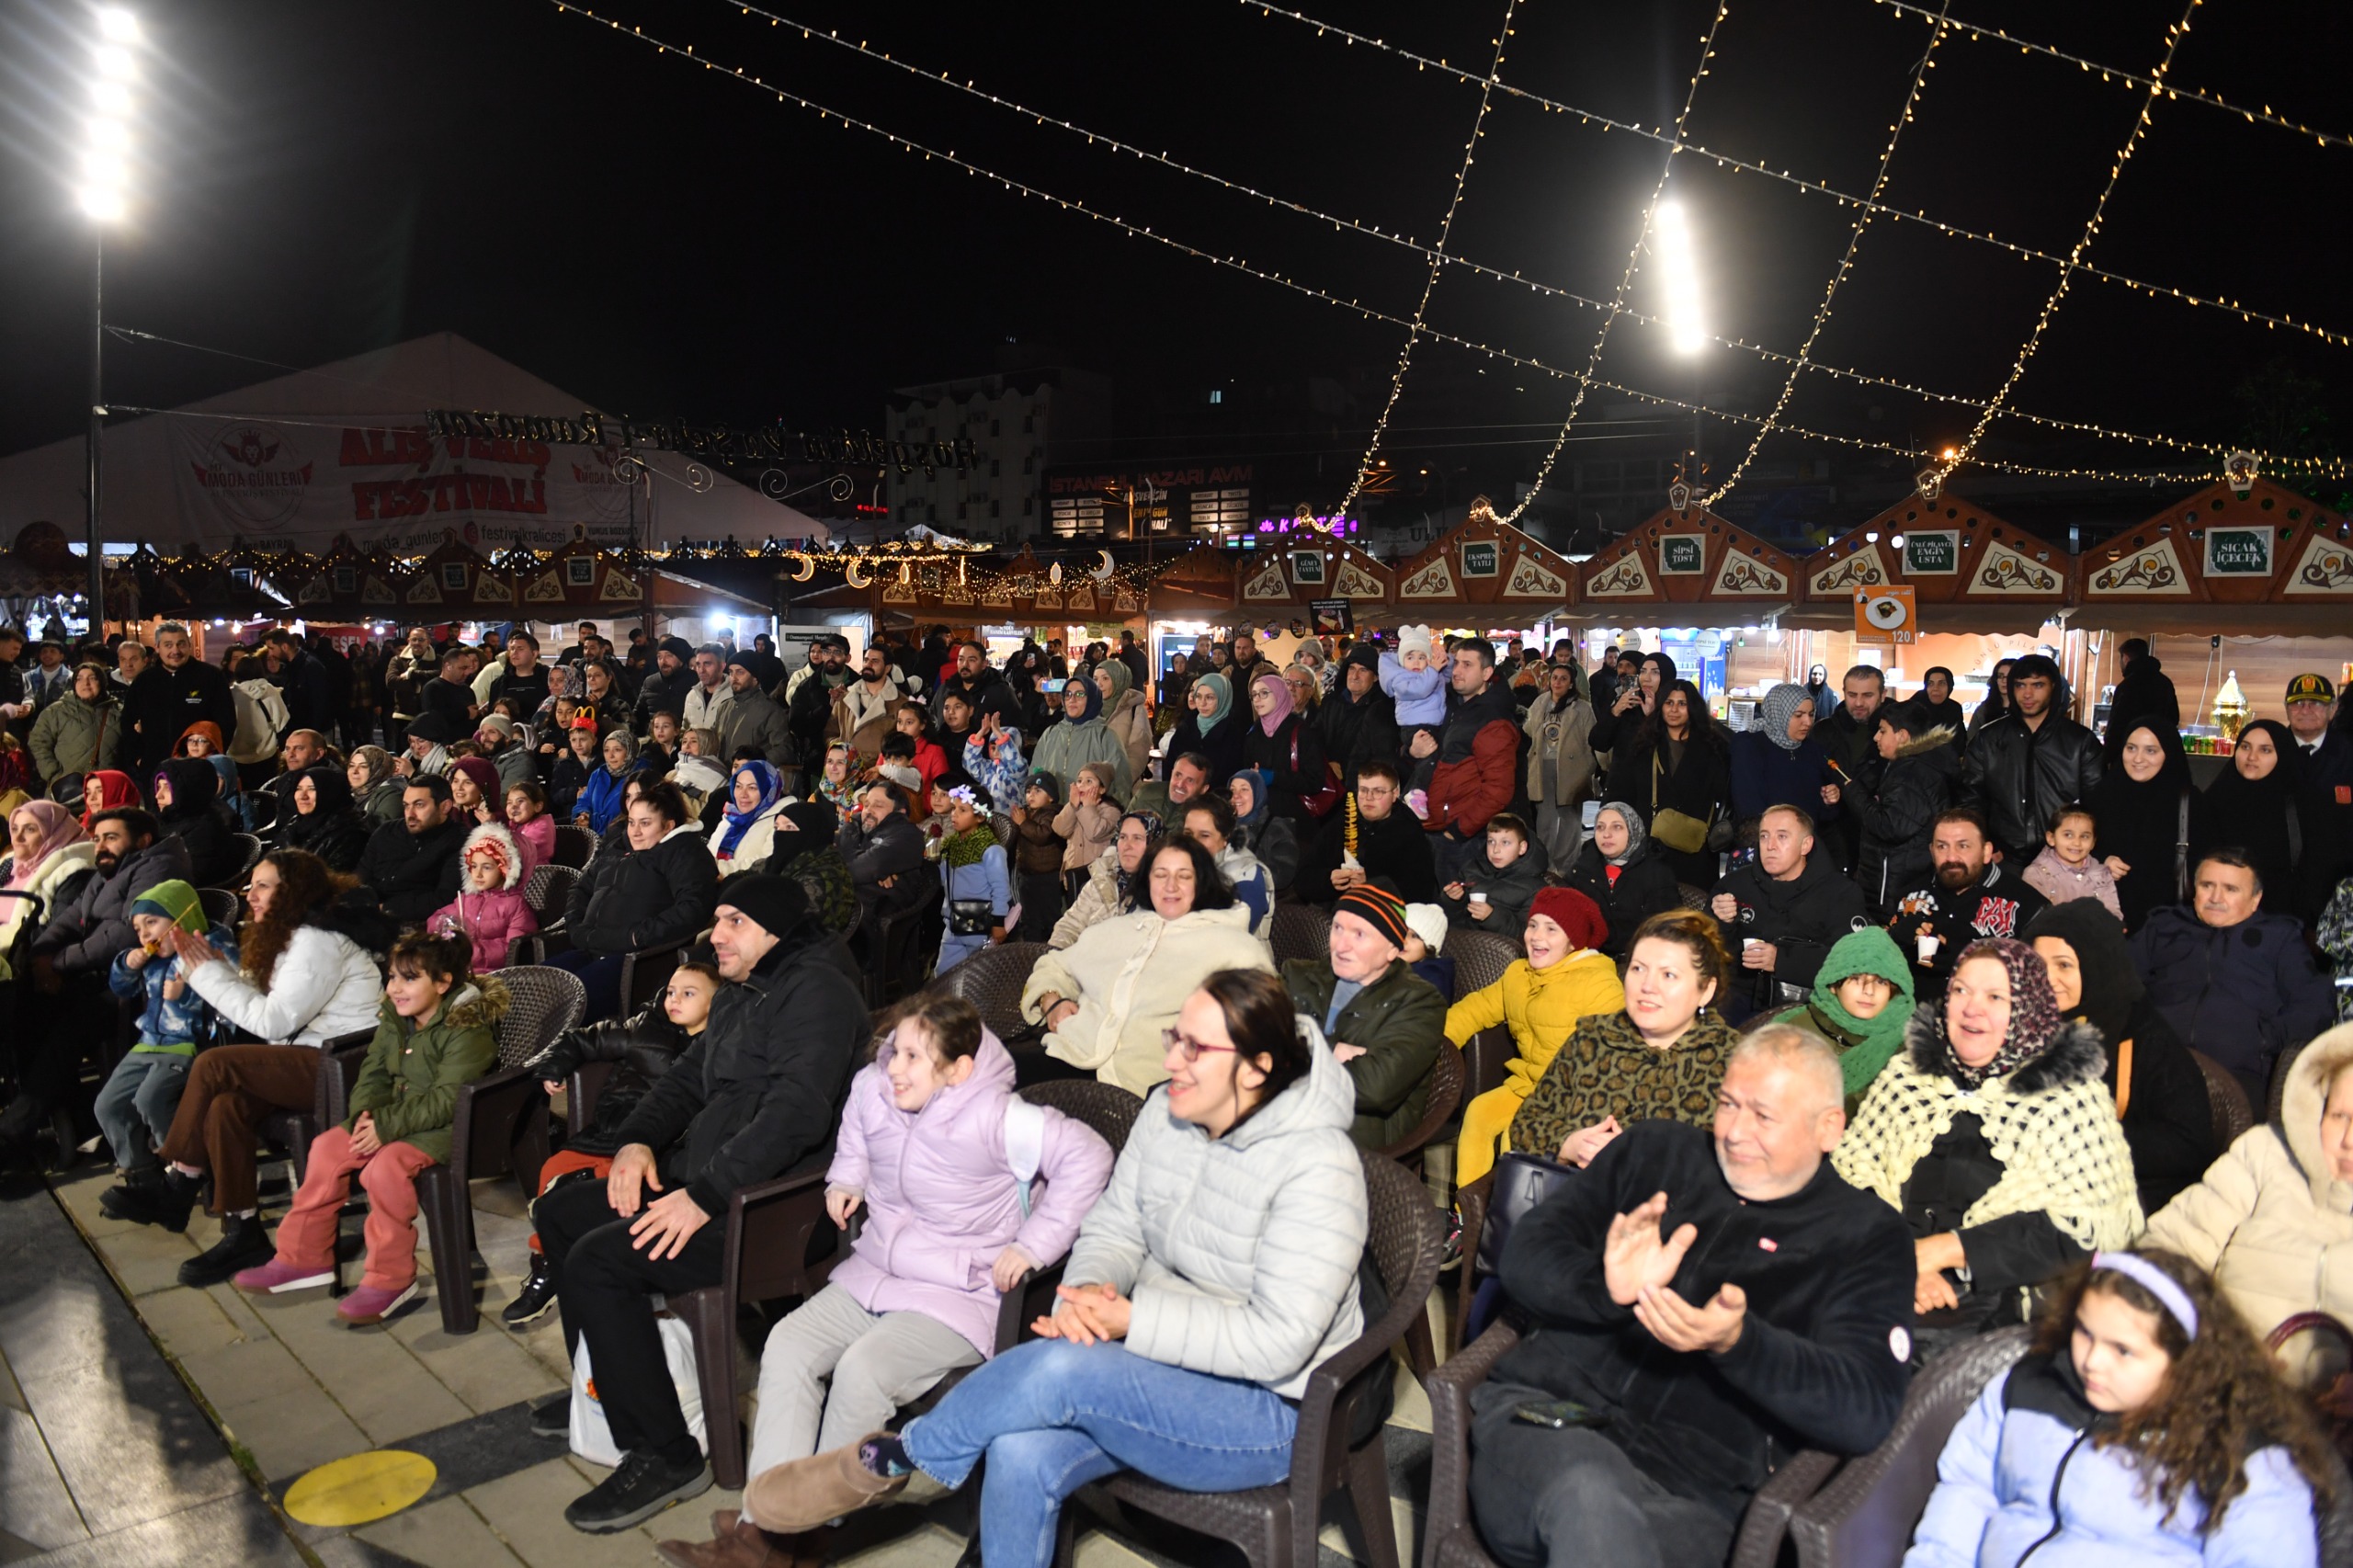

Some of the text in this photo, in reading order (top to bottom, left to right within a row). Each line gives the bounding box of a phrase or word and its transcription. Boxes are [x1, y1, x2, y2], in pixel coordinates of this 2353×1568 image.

[339, 425, 434, 472] ALIŞ
[207, 472, 245, 488] MODA
[1209, 465, 1254, 484] AVM
[352, 465, 548, 520] FESTİVALİ
[1673, 544, 1694, 555] SİPSİ
[1916, 546, 1945, 556] ENGİN
[2221, 542, 2257, 552] SICAK
[1467, 552, 1496, 561] EKSPRES
[1672, 553, 1695, 562] TOST
[1918, 555, 1942, 563] USTA
[2216, 551, 2261, 566] İÇECEK
[1472, 560, 1492, 568] TATLI
[1892, 630, 1911, 642] 120
